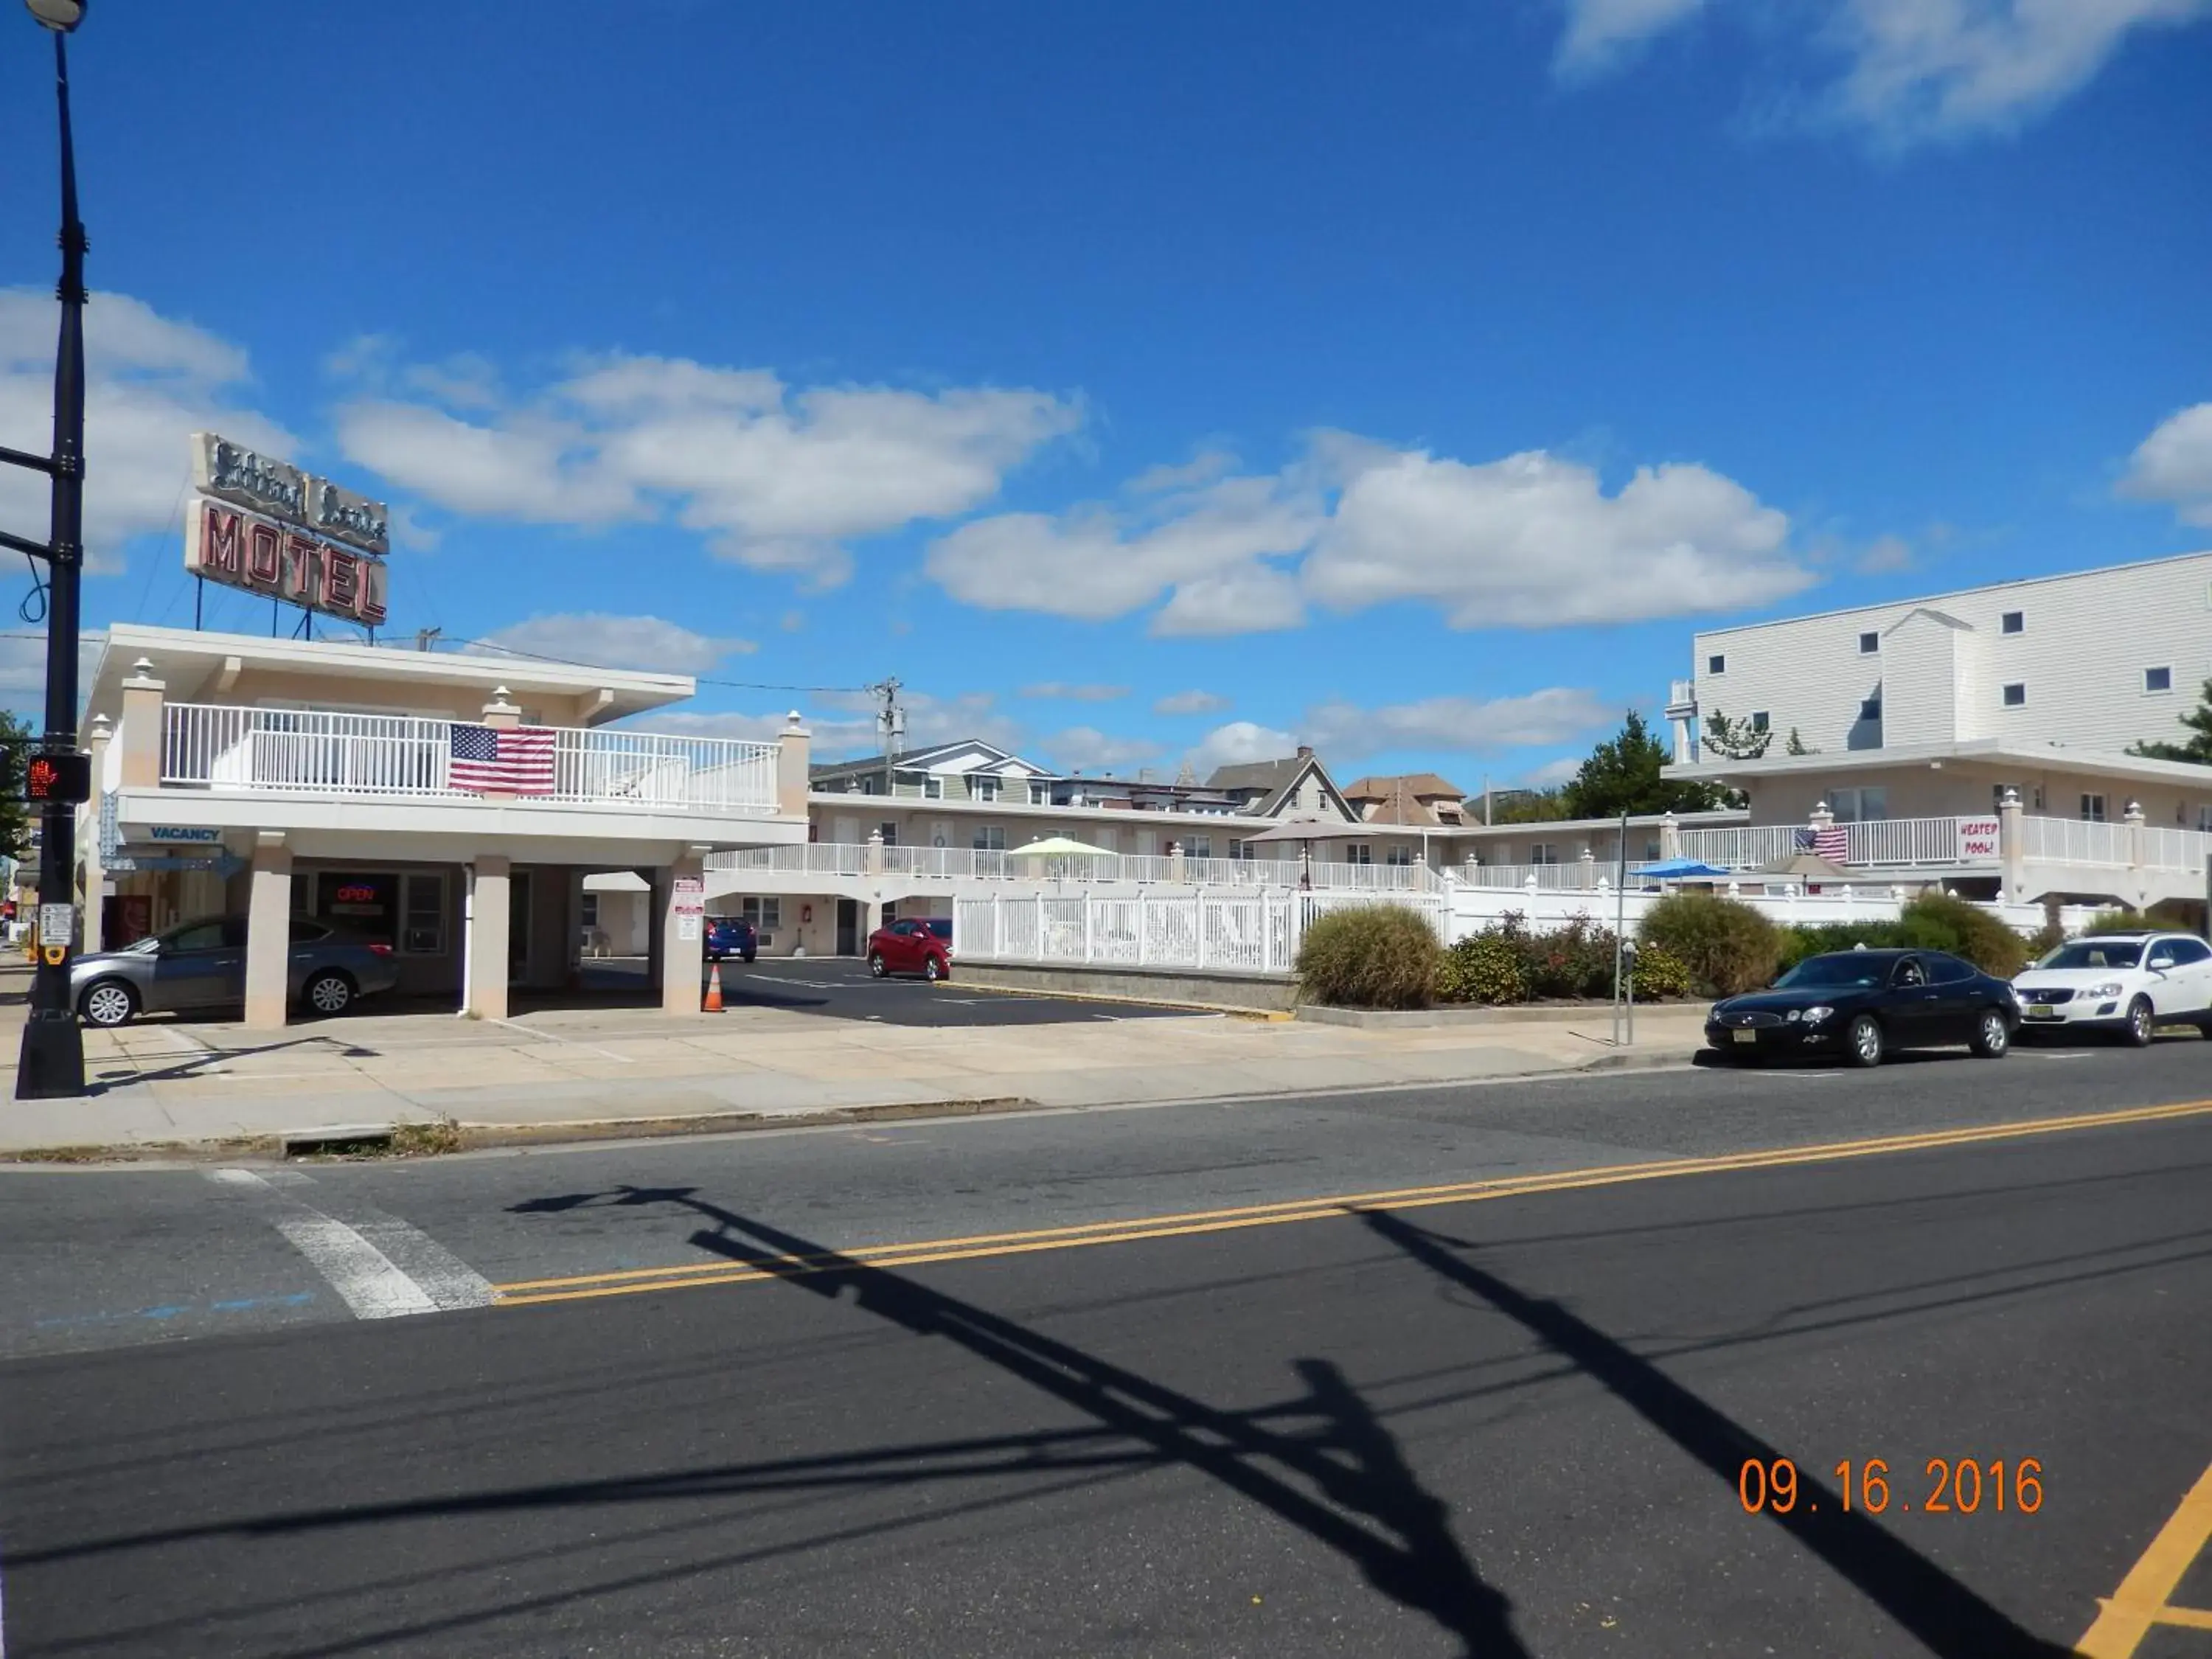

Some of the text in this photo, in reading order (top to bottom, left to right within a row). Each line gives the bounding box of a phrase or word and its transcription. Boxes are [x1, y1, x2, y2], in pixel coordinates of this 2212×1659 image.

[200, 507, 387, 622] MOTEL
[151, 827, 220, 841] VACANCY
[338, 888, 375, 900] OPEN
